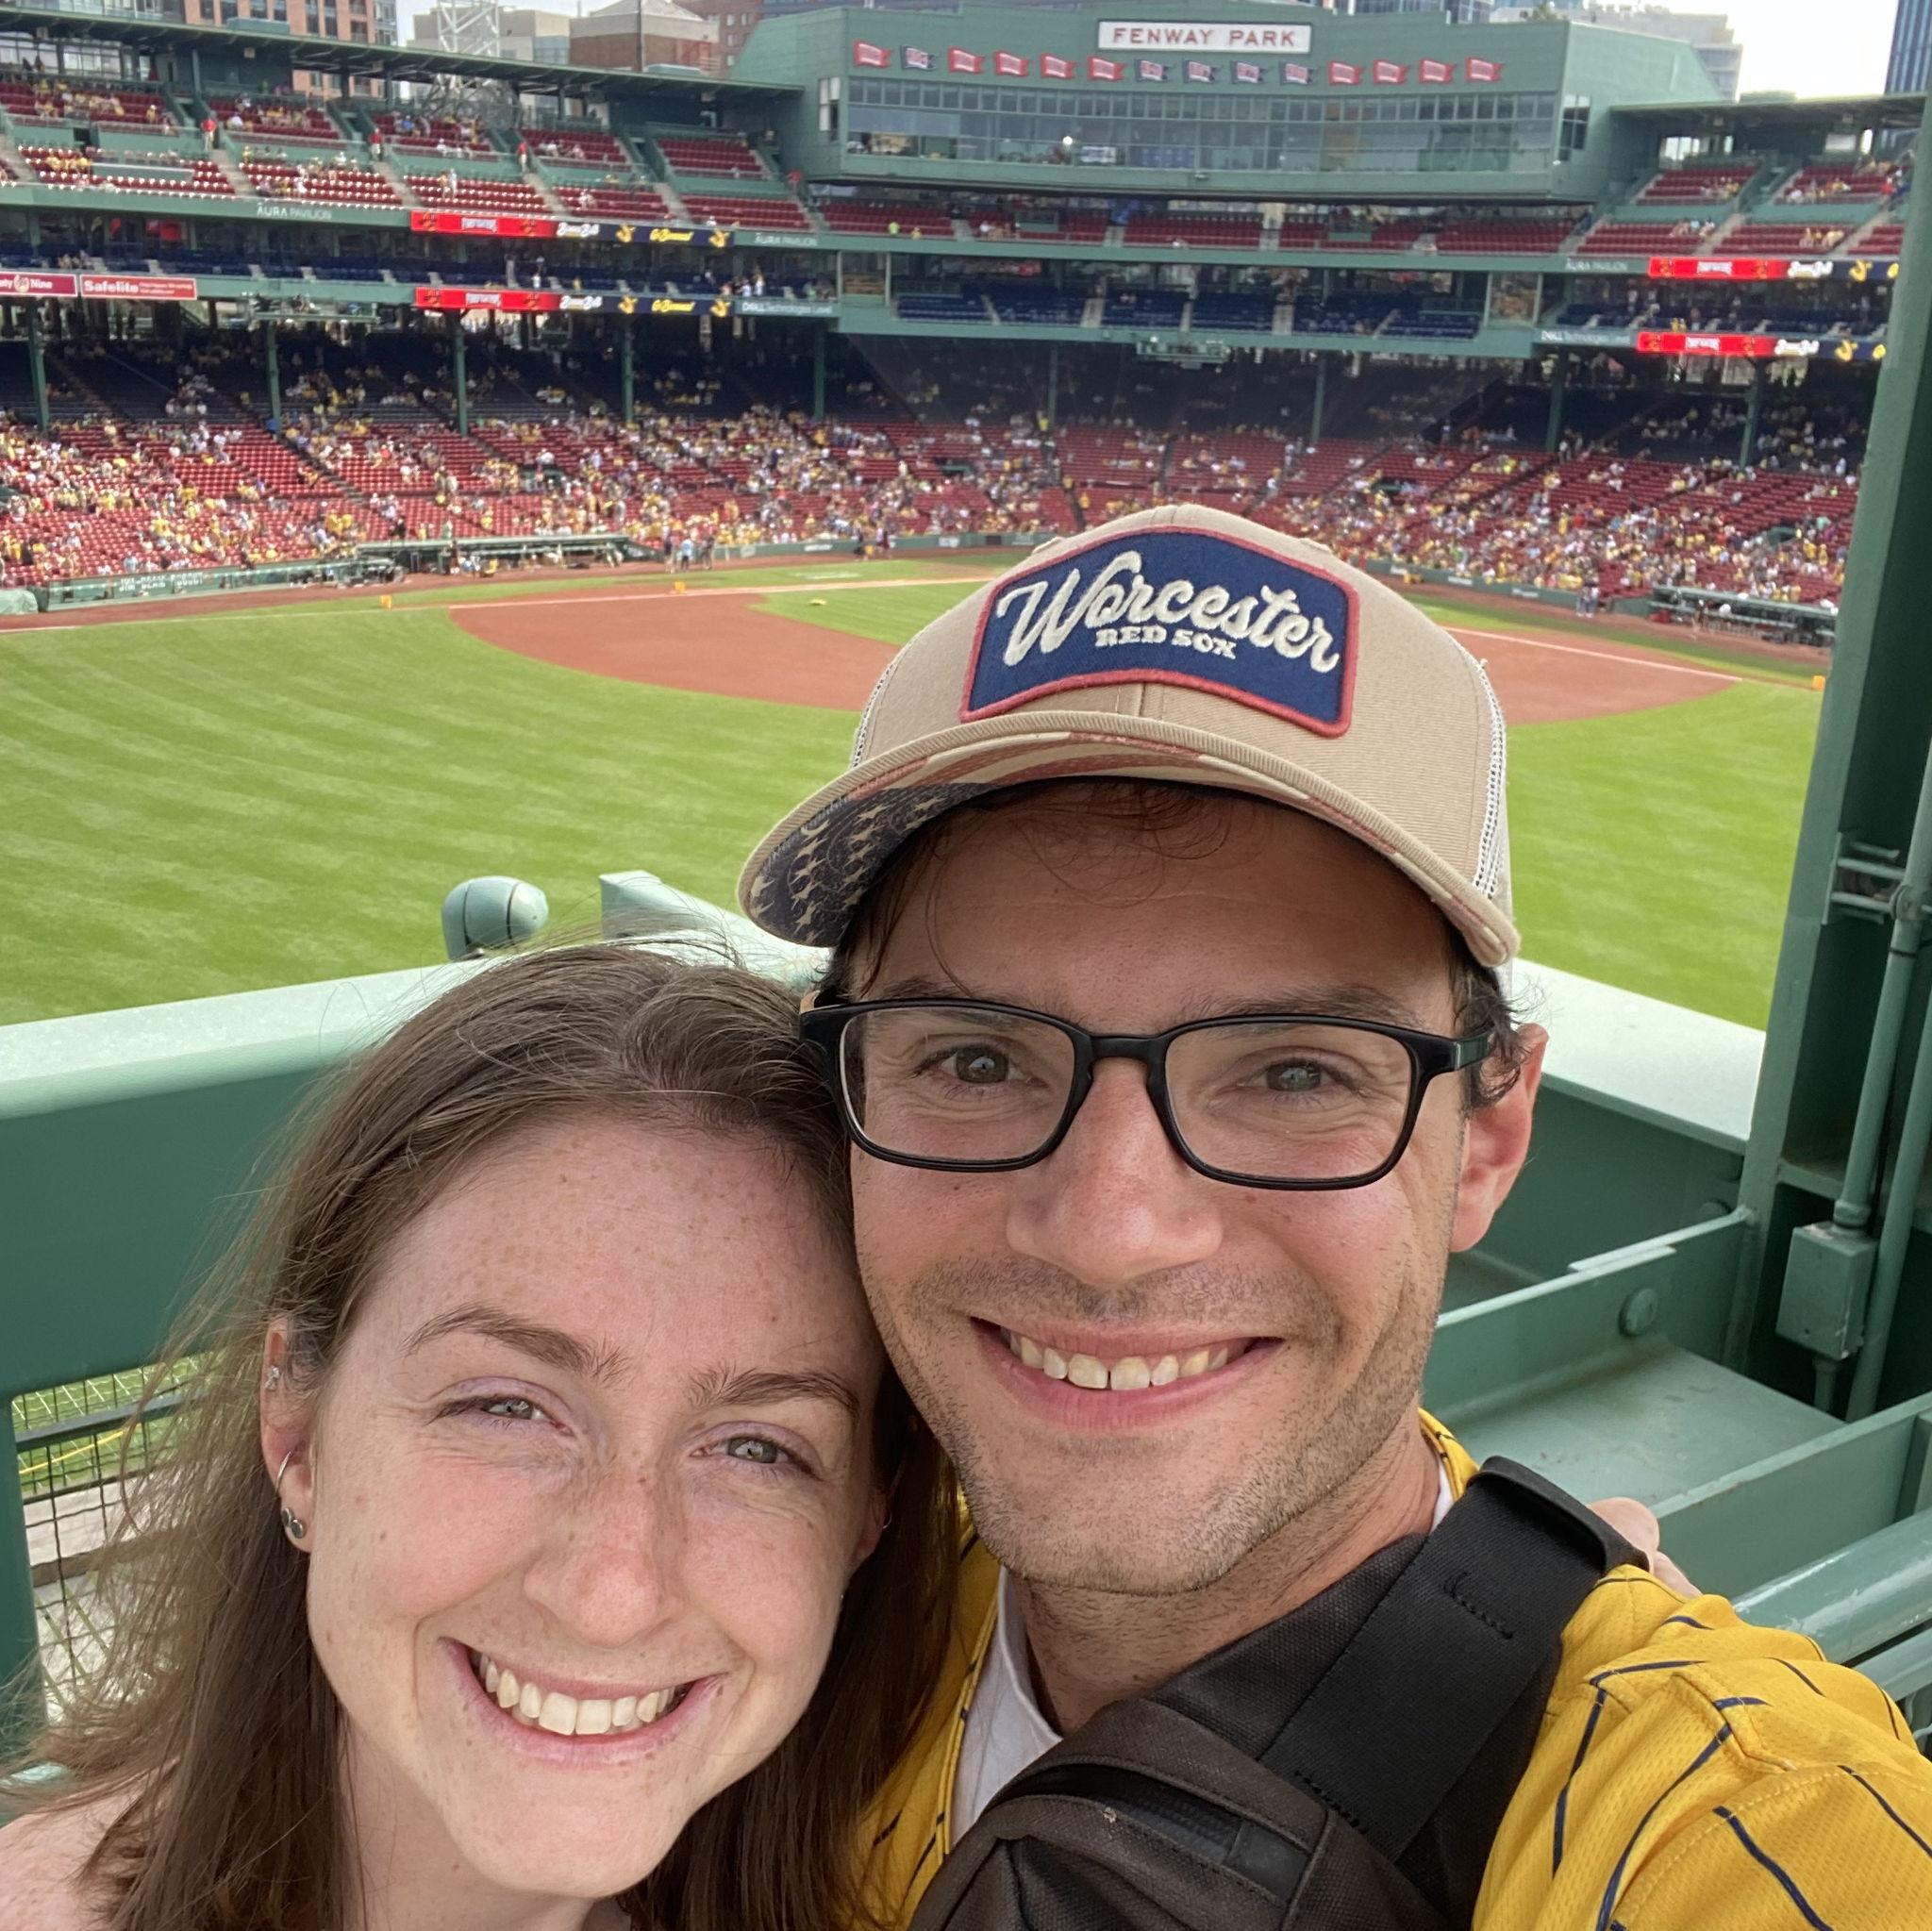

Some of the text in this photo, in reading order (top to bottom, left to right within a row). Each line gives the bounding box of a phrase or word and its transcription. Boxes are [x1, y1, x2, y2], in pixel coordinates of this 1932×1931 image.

[1112, 27, 1295, 46] FENWAY PARK
[290, 208, 332, 220] PAVILION
[30, 278, 53, 290] Nine
[84, 280, 140, 293] Safelite
[996, 550, 1341, 674] Worcester
[1095, 625, 1238, 659] RED SOX
